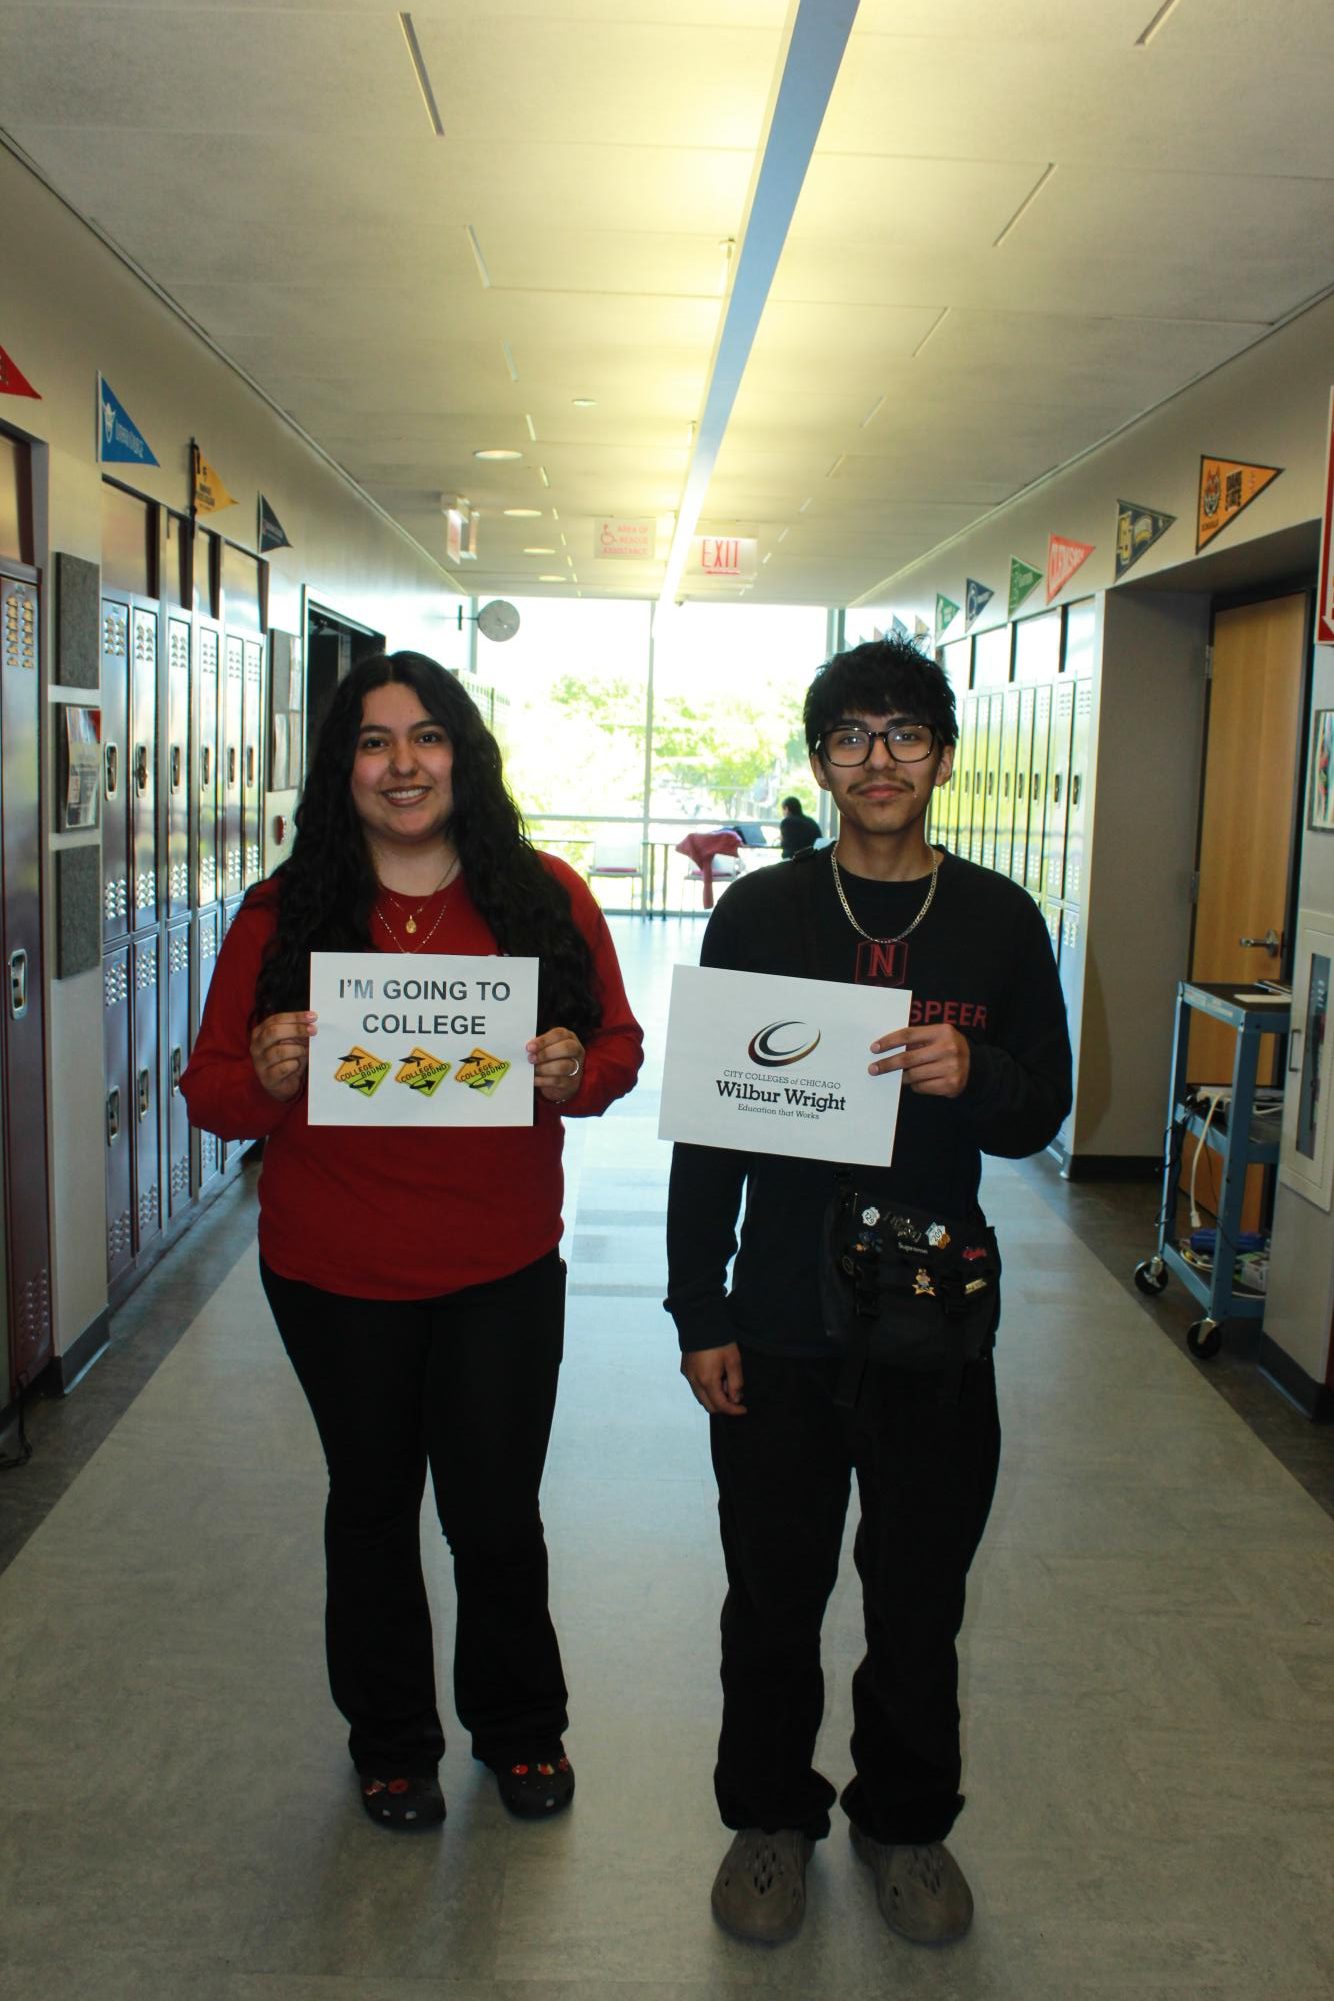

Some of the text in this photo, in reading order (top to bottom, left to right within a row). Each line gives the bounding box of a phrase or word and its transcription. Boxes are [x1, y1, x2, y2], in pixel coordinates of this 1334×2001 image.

[702, 539, 741, 568] EXIT
[868, 943, 896, 977] N
[339, 979, 511, 1001] I'M GOING TO
[362, 1014, 486, 1035] COLLEGE
[909, 1000, 988, 1030] SPEER
[340, 1062, 373, 1082] COLLEGE
[360, 1063, 388, 1078] BOUND
[400, 1062, 434, 1083] COLLEGE
[421, 1063, 448, 1079] BOUND
[460, 1062, 493, 1082] COLLEGE
[480, 1063, 507, 1078] BOUND
[723, 1070, 744, 1079] CITY
[744, 1072, 789, 1084] COLLEGES
[799, 1079, 842, 1090] CHICAGO
[716, 1080, 847, 1112] Wilbur Wright
[737, 1103, 820, 1120] Education that Works
